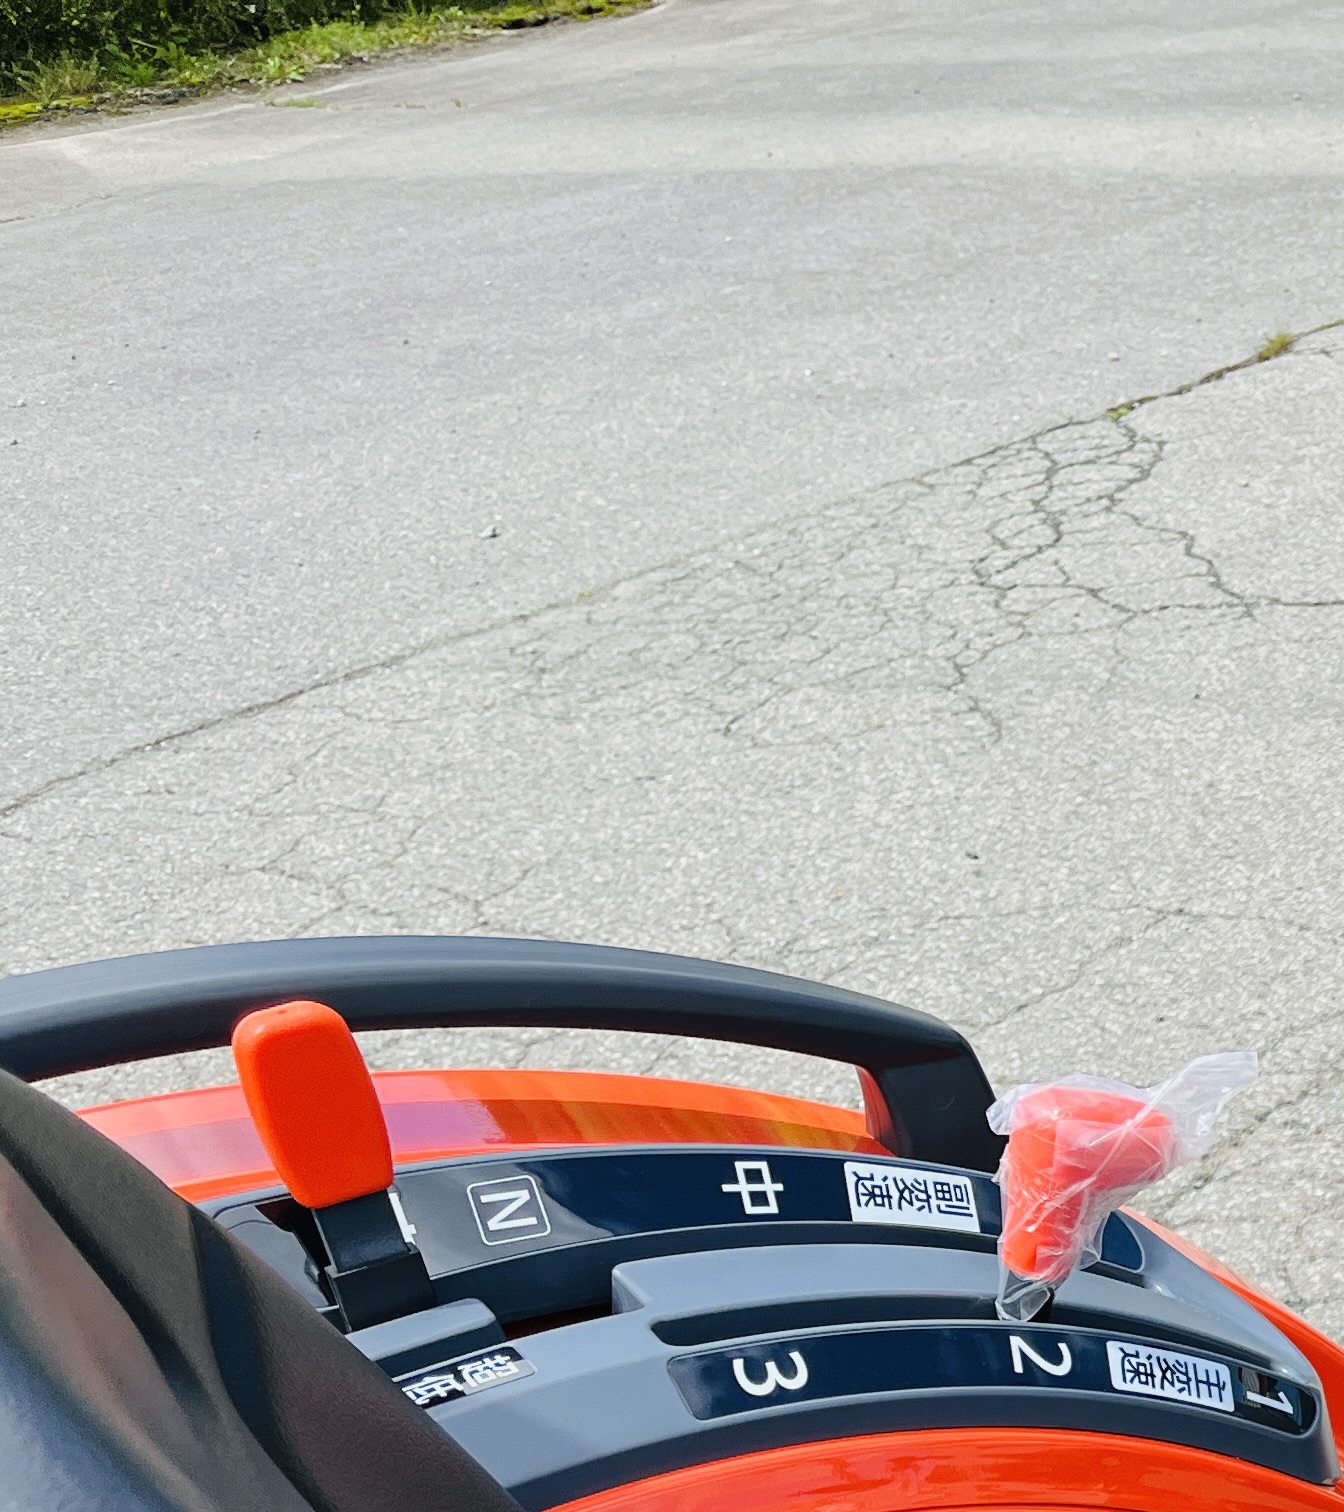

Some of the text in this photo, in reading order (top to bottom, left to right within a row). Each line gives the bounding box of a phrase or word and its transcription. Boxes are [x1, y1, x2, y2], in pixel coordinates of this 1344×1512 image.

[480, 1188, 538, 1232] N
[722, 1160, 784, 1215] 中
[852, 1170, 974, 1218] 副変速
[732, 1350, 809, 1396] 3
[1009, 1335, 1073, 1377] 2
[1119, 1346, 1226, 1403] 主変速
[1245, 1390, 1295, 1416] 1
